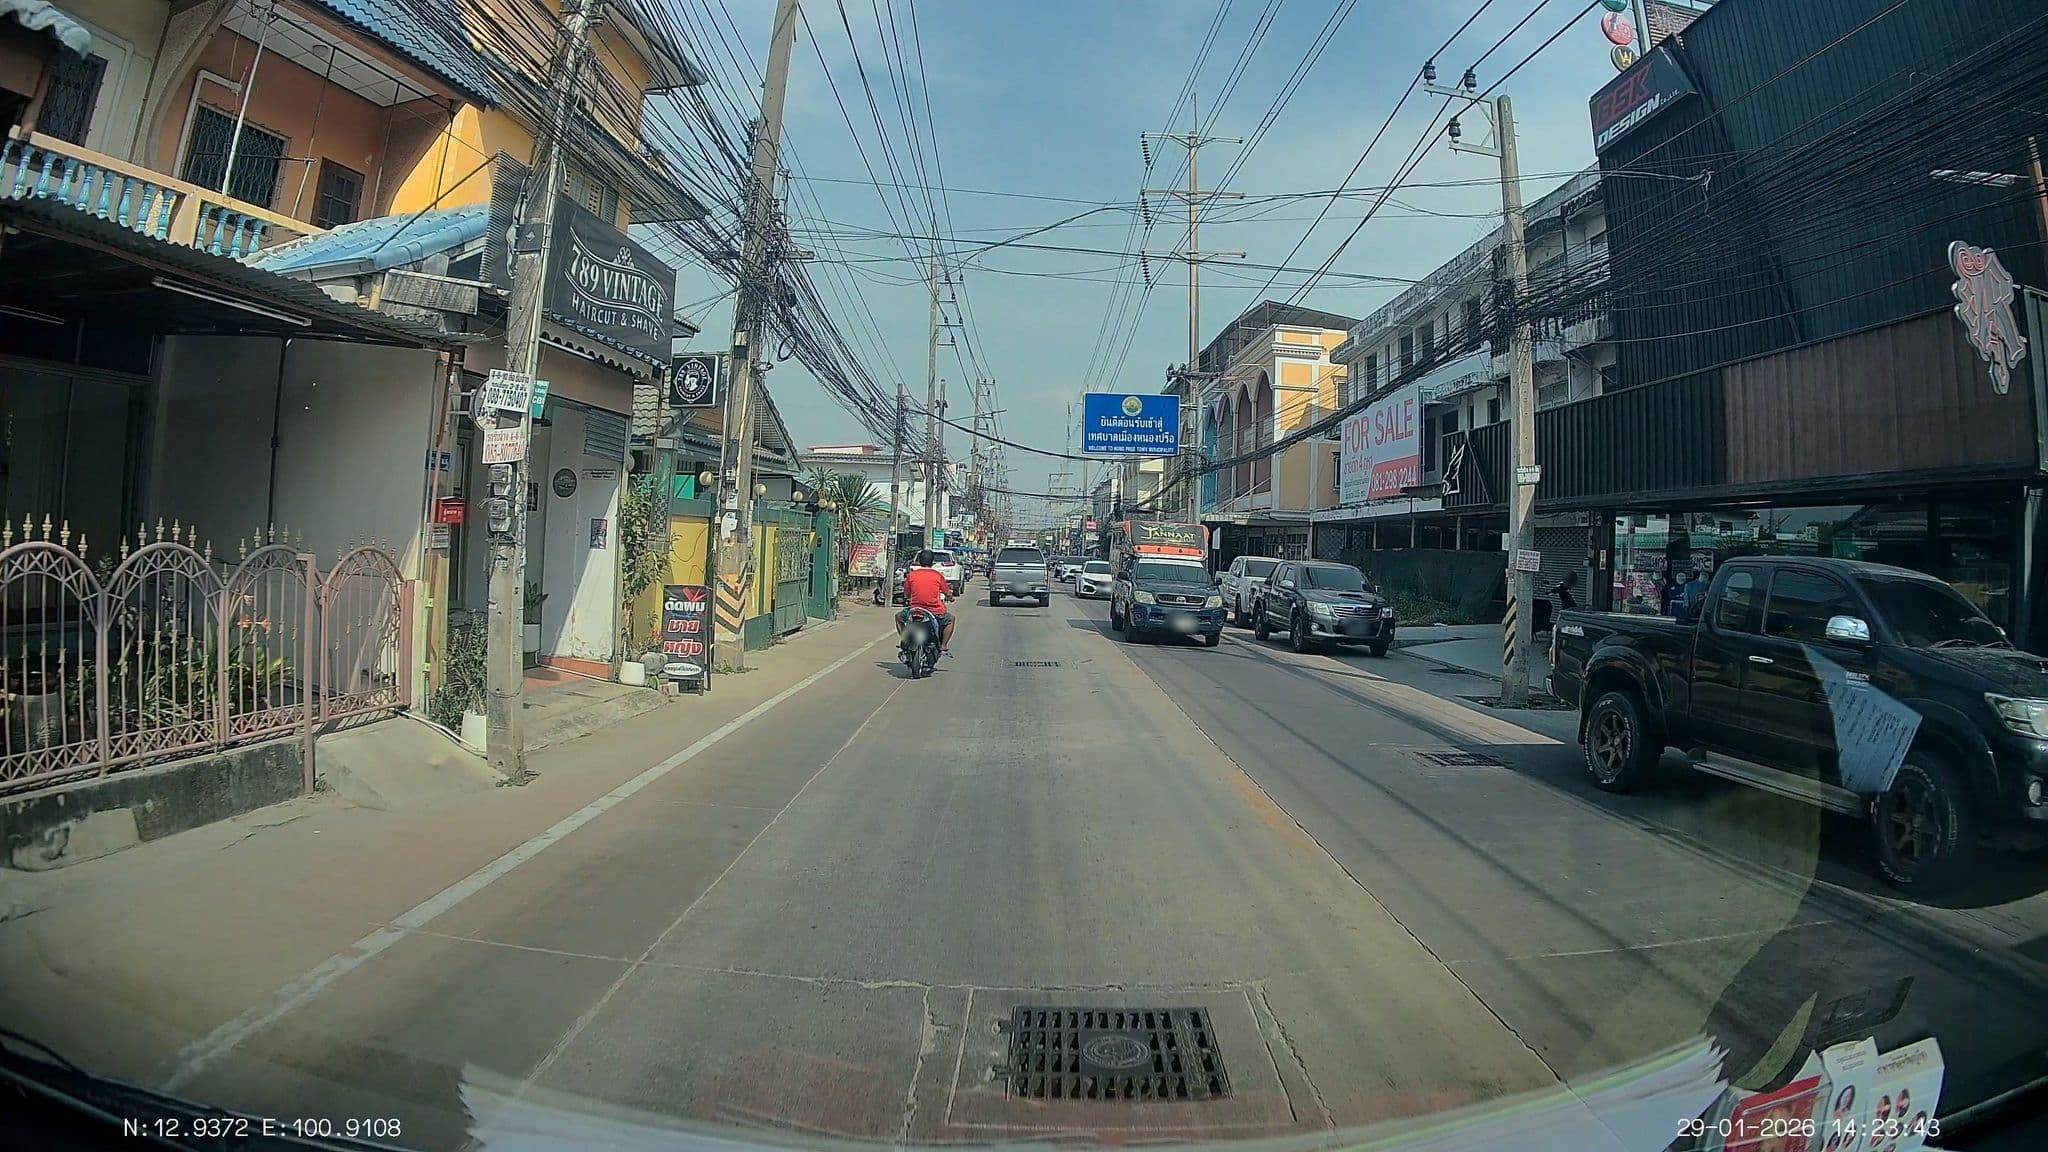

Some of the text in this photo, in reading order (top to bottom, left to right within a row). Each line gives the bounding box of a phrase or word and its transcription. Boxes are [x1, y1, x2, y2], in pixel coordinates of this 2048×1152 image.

[1597, 93, 1661, 148] DESIGN
[571, 245, 664, 322] 789 VINTAGE
[572, 292, 659, 341] HAIRCUT & SHAVE
[1088, 430, 1175, 443] เทศบาลเมืองหนองปรือ
[1100, 416, 1163, 432] ยินดีต้อนรับเข้าสู่
[1344, 399, 1414, 455] FOR SALE
[668, 619, 700, 633] ชาย
[663, 639, 702, 657] หญิง
